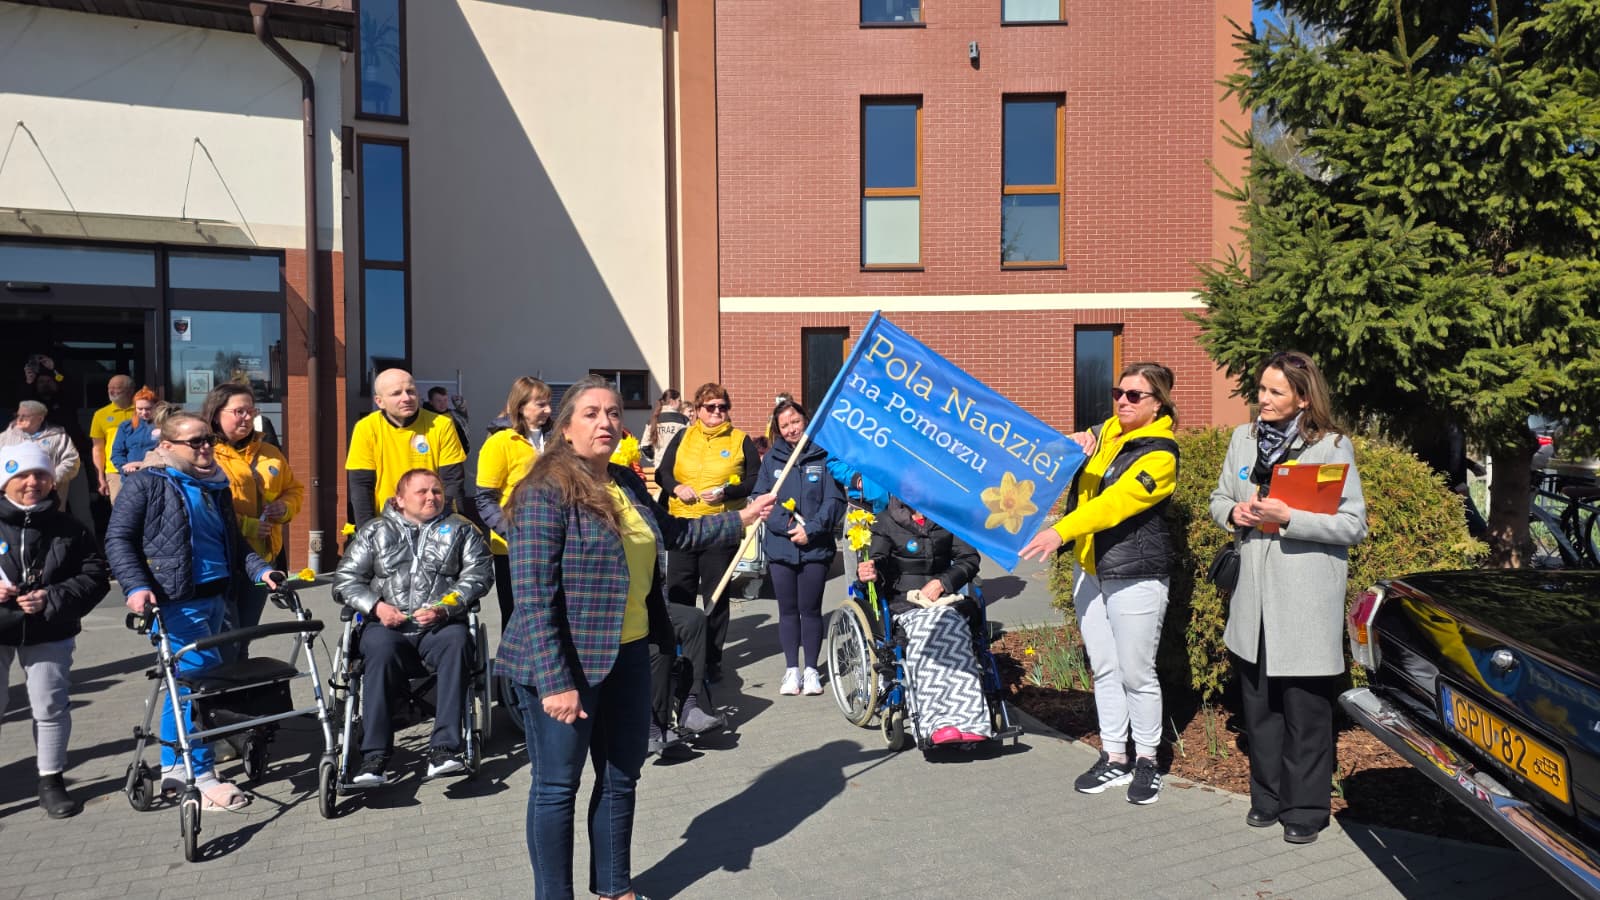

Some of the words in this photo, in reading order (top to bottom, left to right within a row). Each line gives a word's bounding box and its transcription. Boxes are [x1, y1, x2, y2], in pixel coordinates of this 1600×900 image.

[831, 399, 892, 448] 2026
[849, 373, 880, 401] na
[884, 392, 988, 473] Pomorzu
[864, 333, 935, 400] Pola
[941, 387, 1064, 482] Nadziei
[1456, 698, 1493, 750] GPU
[1501, 726, 1528, 776] 82
